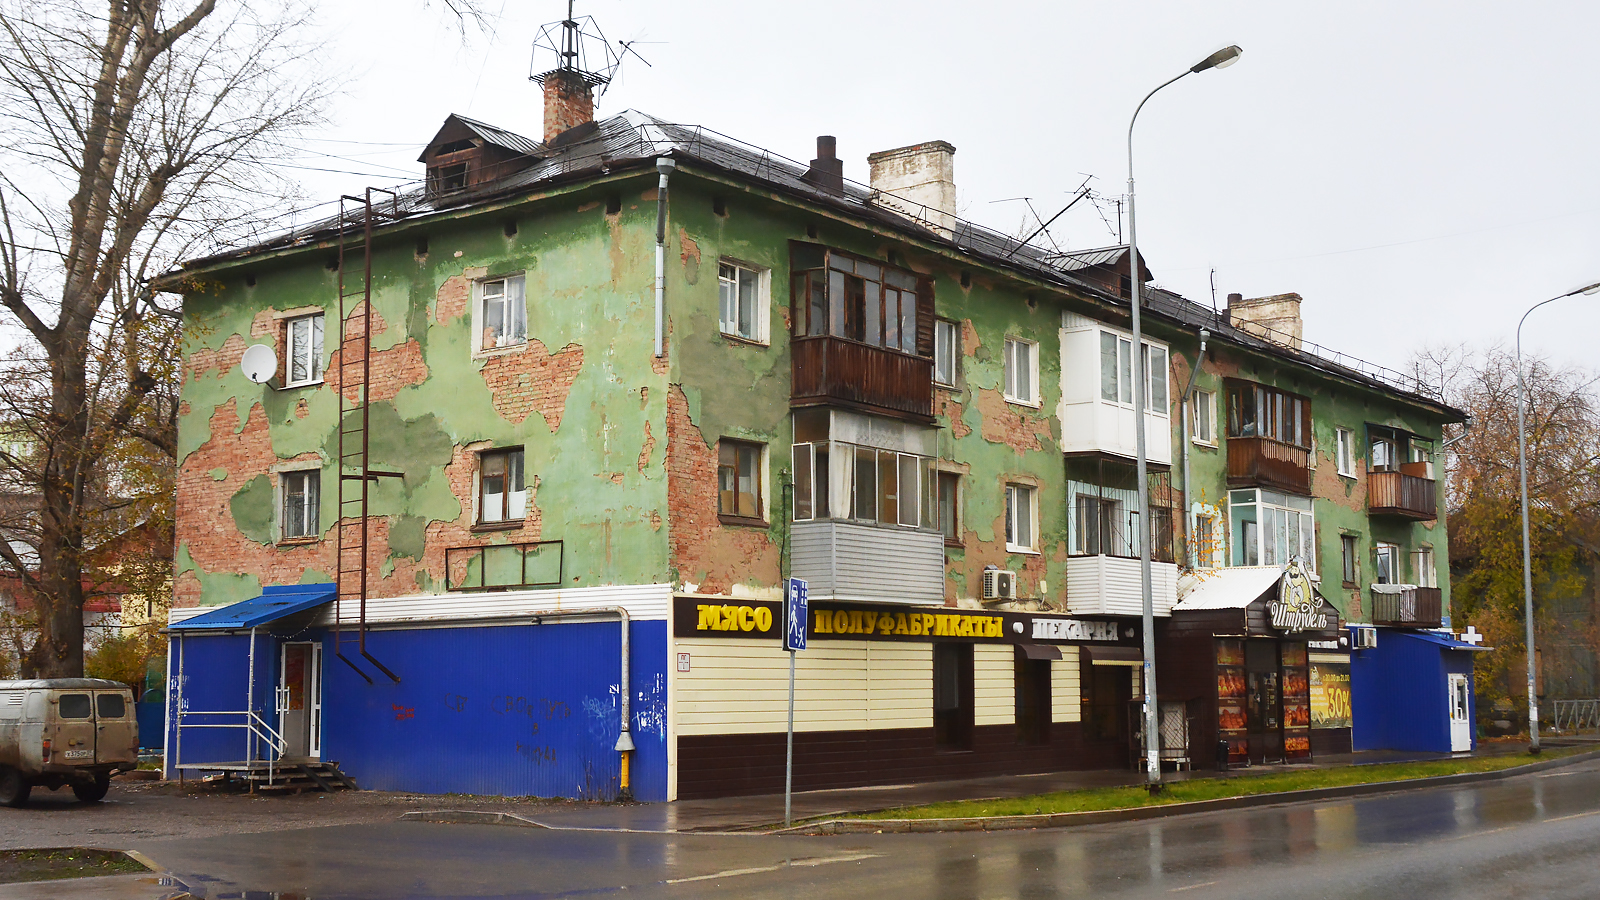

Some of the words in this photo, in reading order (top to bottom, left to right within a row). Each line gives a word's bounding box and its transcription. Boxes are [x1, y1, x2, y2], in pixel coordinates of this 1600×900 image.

[696, 604, 773, 632] МЯСО
[814, 609, 1004, 638] ПОЛУФАБРИКАТЫ
[1031, 618, 1119, 641] ПЕКАРНЯ
[1271, 596, 1328, 635] Штрудель
[1328, 687, 1351, 718] 30%
